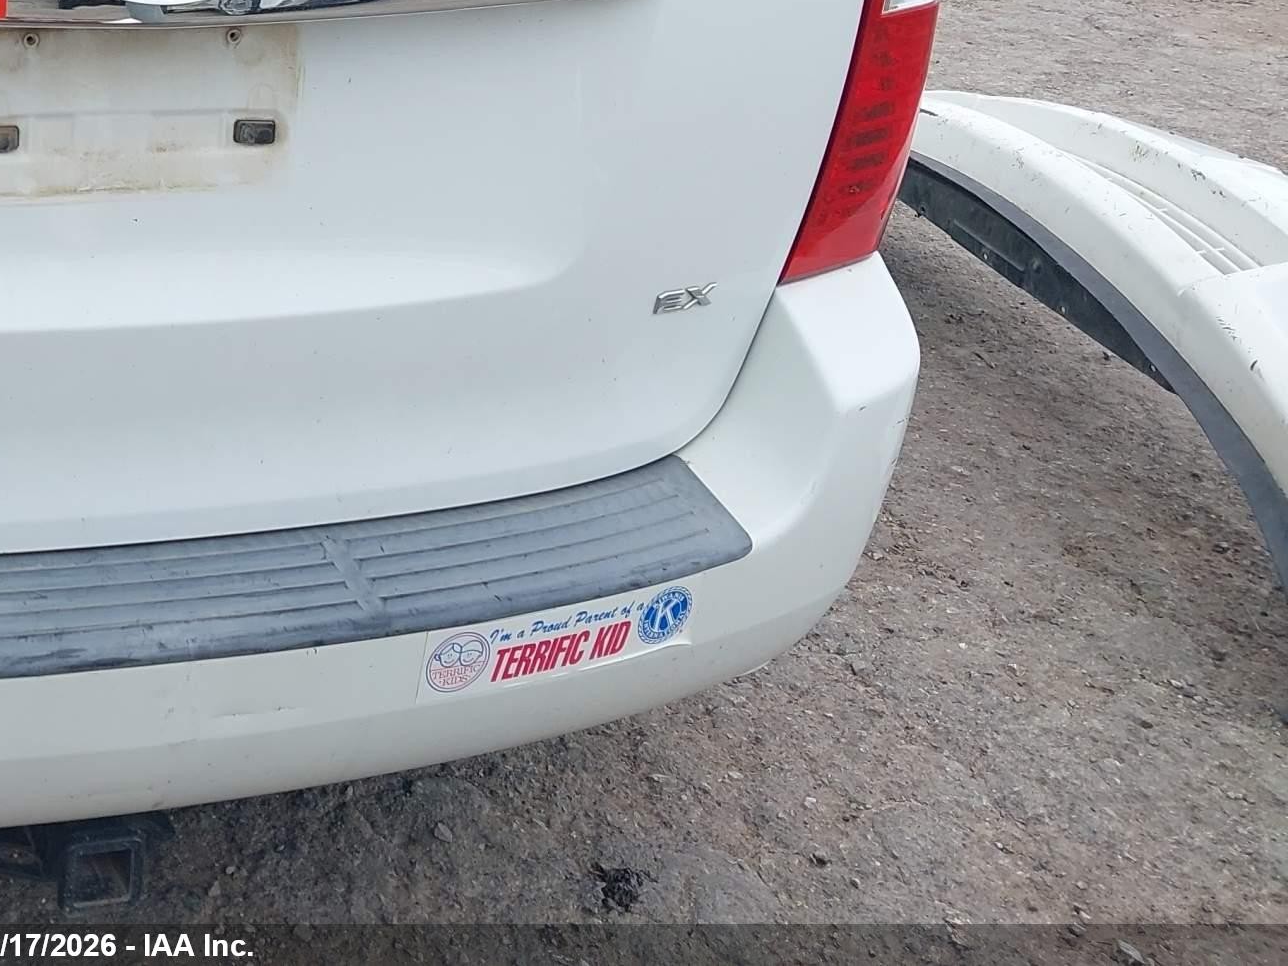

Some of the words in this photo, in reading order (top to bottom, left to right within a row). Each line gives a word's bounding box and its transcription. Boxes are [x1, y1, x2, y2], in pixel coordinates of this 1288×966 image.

[653, 282, 718, 314] EX
[490, 628, 512, 644] I'm
[516, 630, 526, 640] a
[530, 618, 571, 636] Proud
[575, 607, 618, 627] Parent
[621, 600, 635, 618] of
[490, 630, 591, 682] TERRIFIC
[589, 620, 632, 660] KID
[431, 664, 481, 680] TERRIFIC
